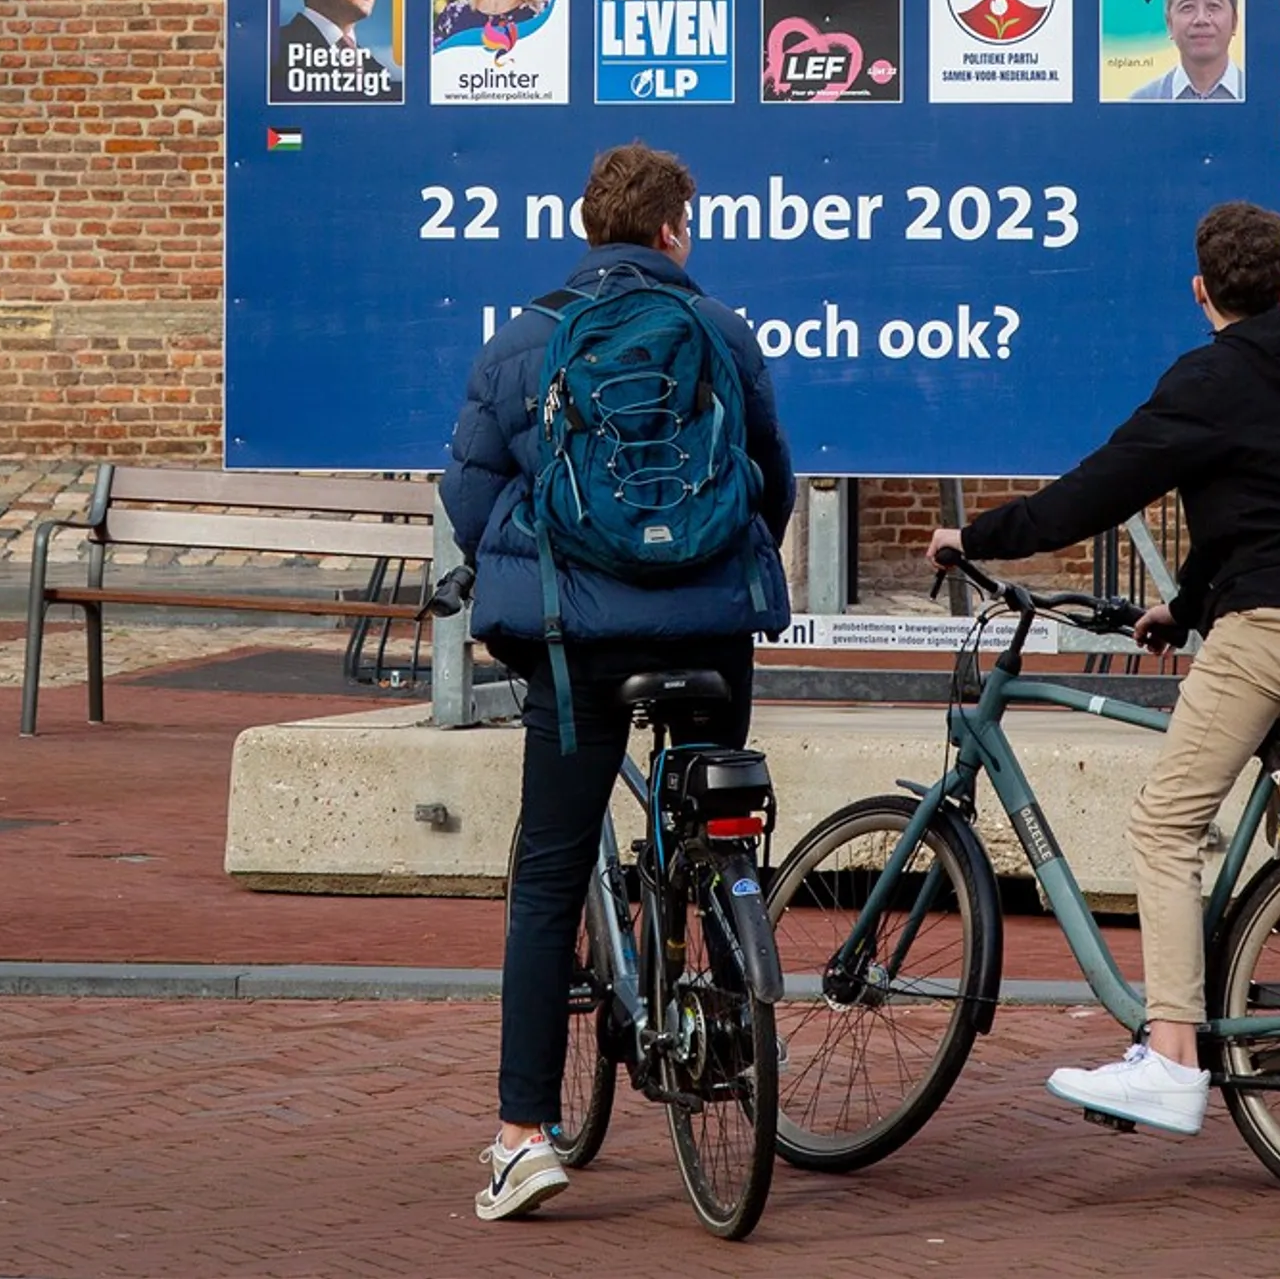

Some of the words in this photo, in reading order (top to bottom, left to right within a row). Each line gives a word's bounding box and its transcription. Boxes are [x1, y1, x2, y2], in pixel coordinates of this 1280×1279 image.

[602, 0, 727, 56] LEVEN
[288, 43, 371, 68] Pieter
[786, 56, 846, 80] LEF
[963, 53, 1005, 64] POLITIEKE
[1007, 52, 1038, 64] PARTIJ
[288, 68, 391, 96] Omtzigt
[459, 69, 539, 94] splinter
[655, 69, 698, 97] LP
[943, 70, 1059, 81] SAMEN-VOOR-NEDERLAND.NL
[444, 91, 553, 101] www.splinterpolitiek.nl
[419, 186, 499, 240] 22
[526, 176, 883, 240] nmber
[905, 185, 1079, 248] 2023
[879, 306, 1020, 361] ook?
[833, 635, 888, 645] gevelreclame
[898, 636, 925, 644] indoor
[928, 636, 957, 646] signing
[1021, 807, 1052, 860] GAZELLE
